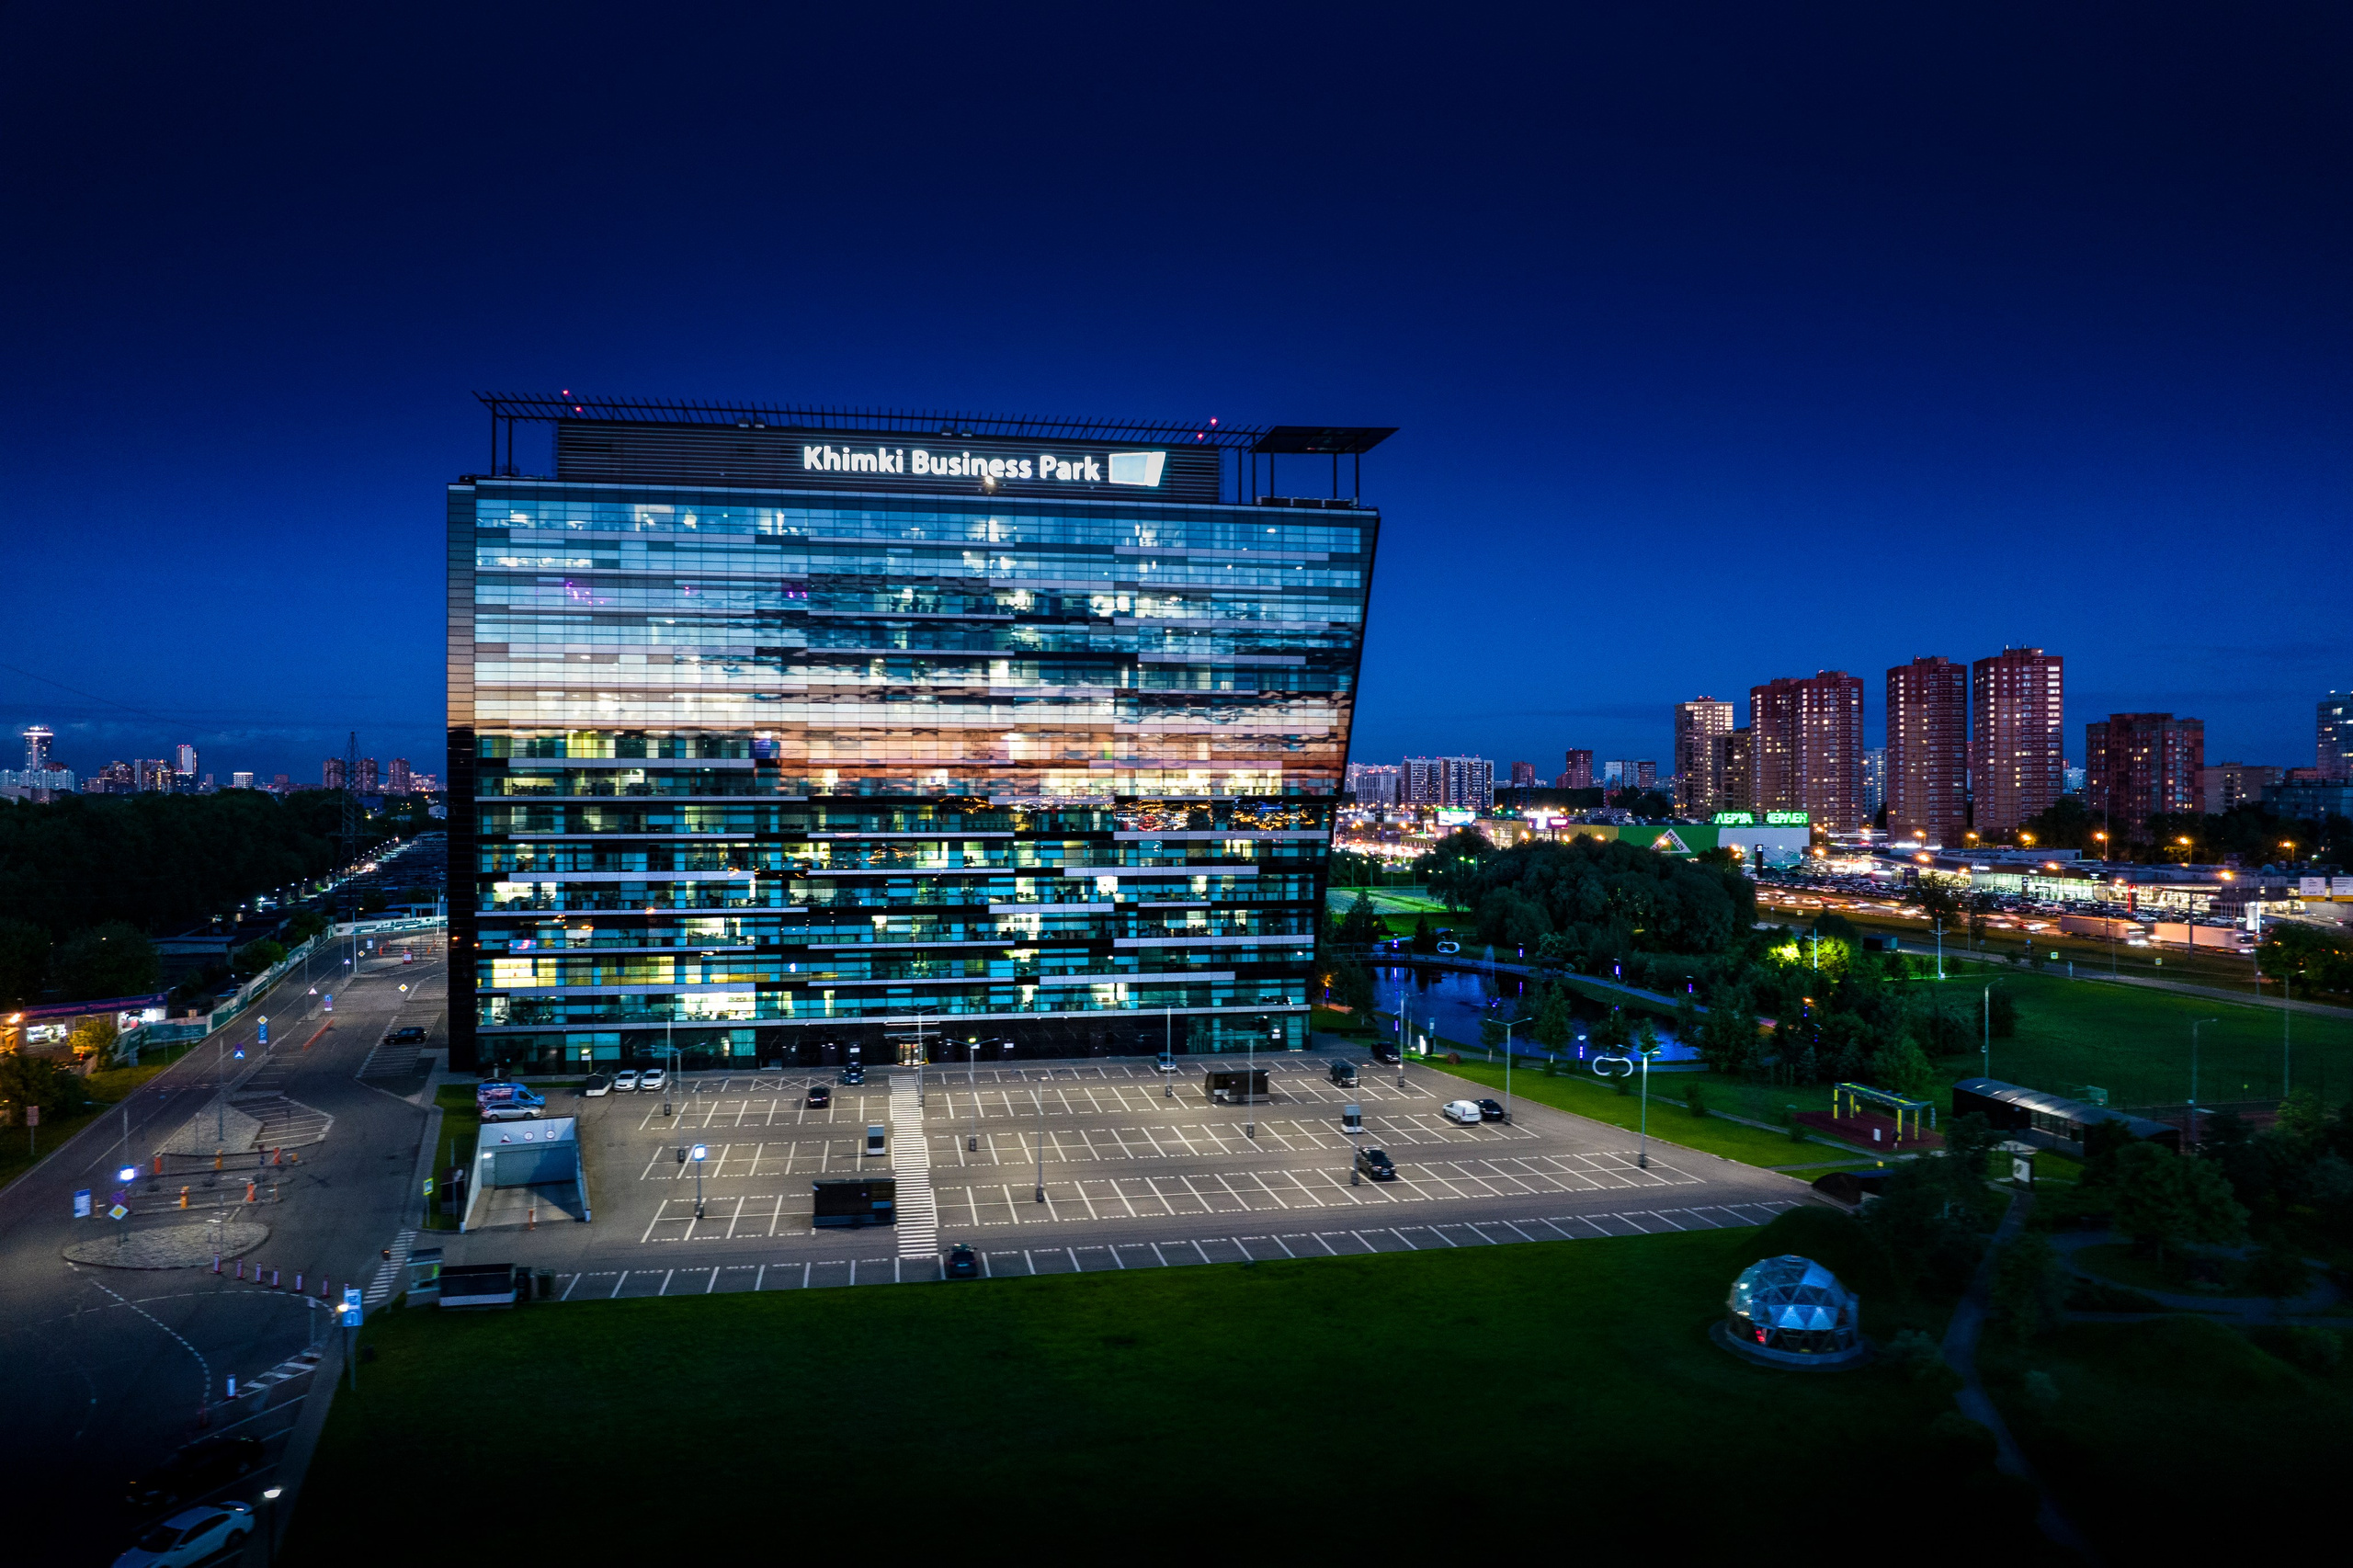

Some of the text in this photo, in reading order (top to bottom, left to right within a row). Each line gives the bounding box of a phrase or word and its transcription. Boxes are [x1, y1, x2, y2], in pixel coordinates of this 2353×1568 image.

[802, 445, 1101, 481] Khimki Business Park
[1668, 832, 1685, 851] MERLIN
